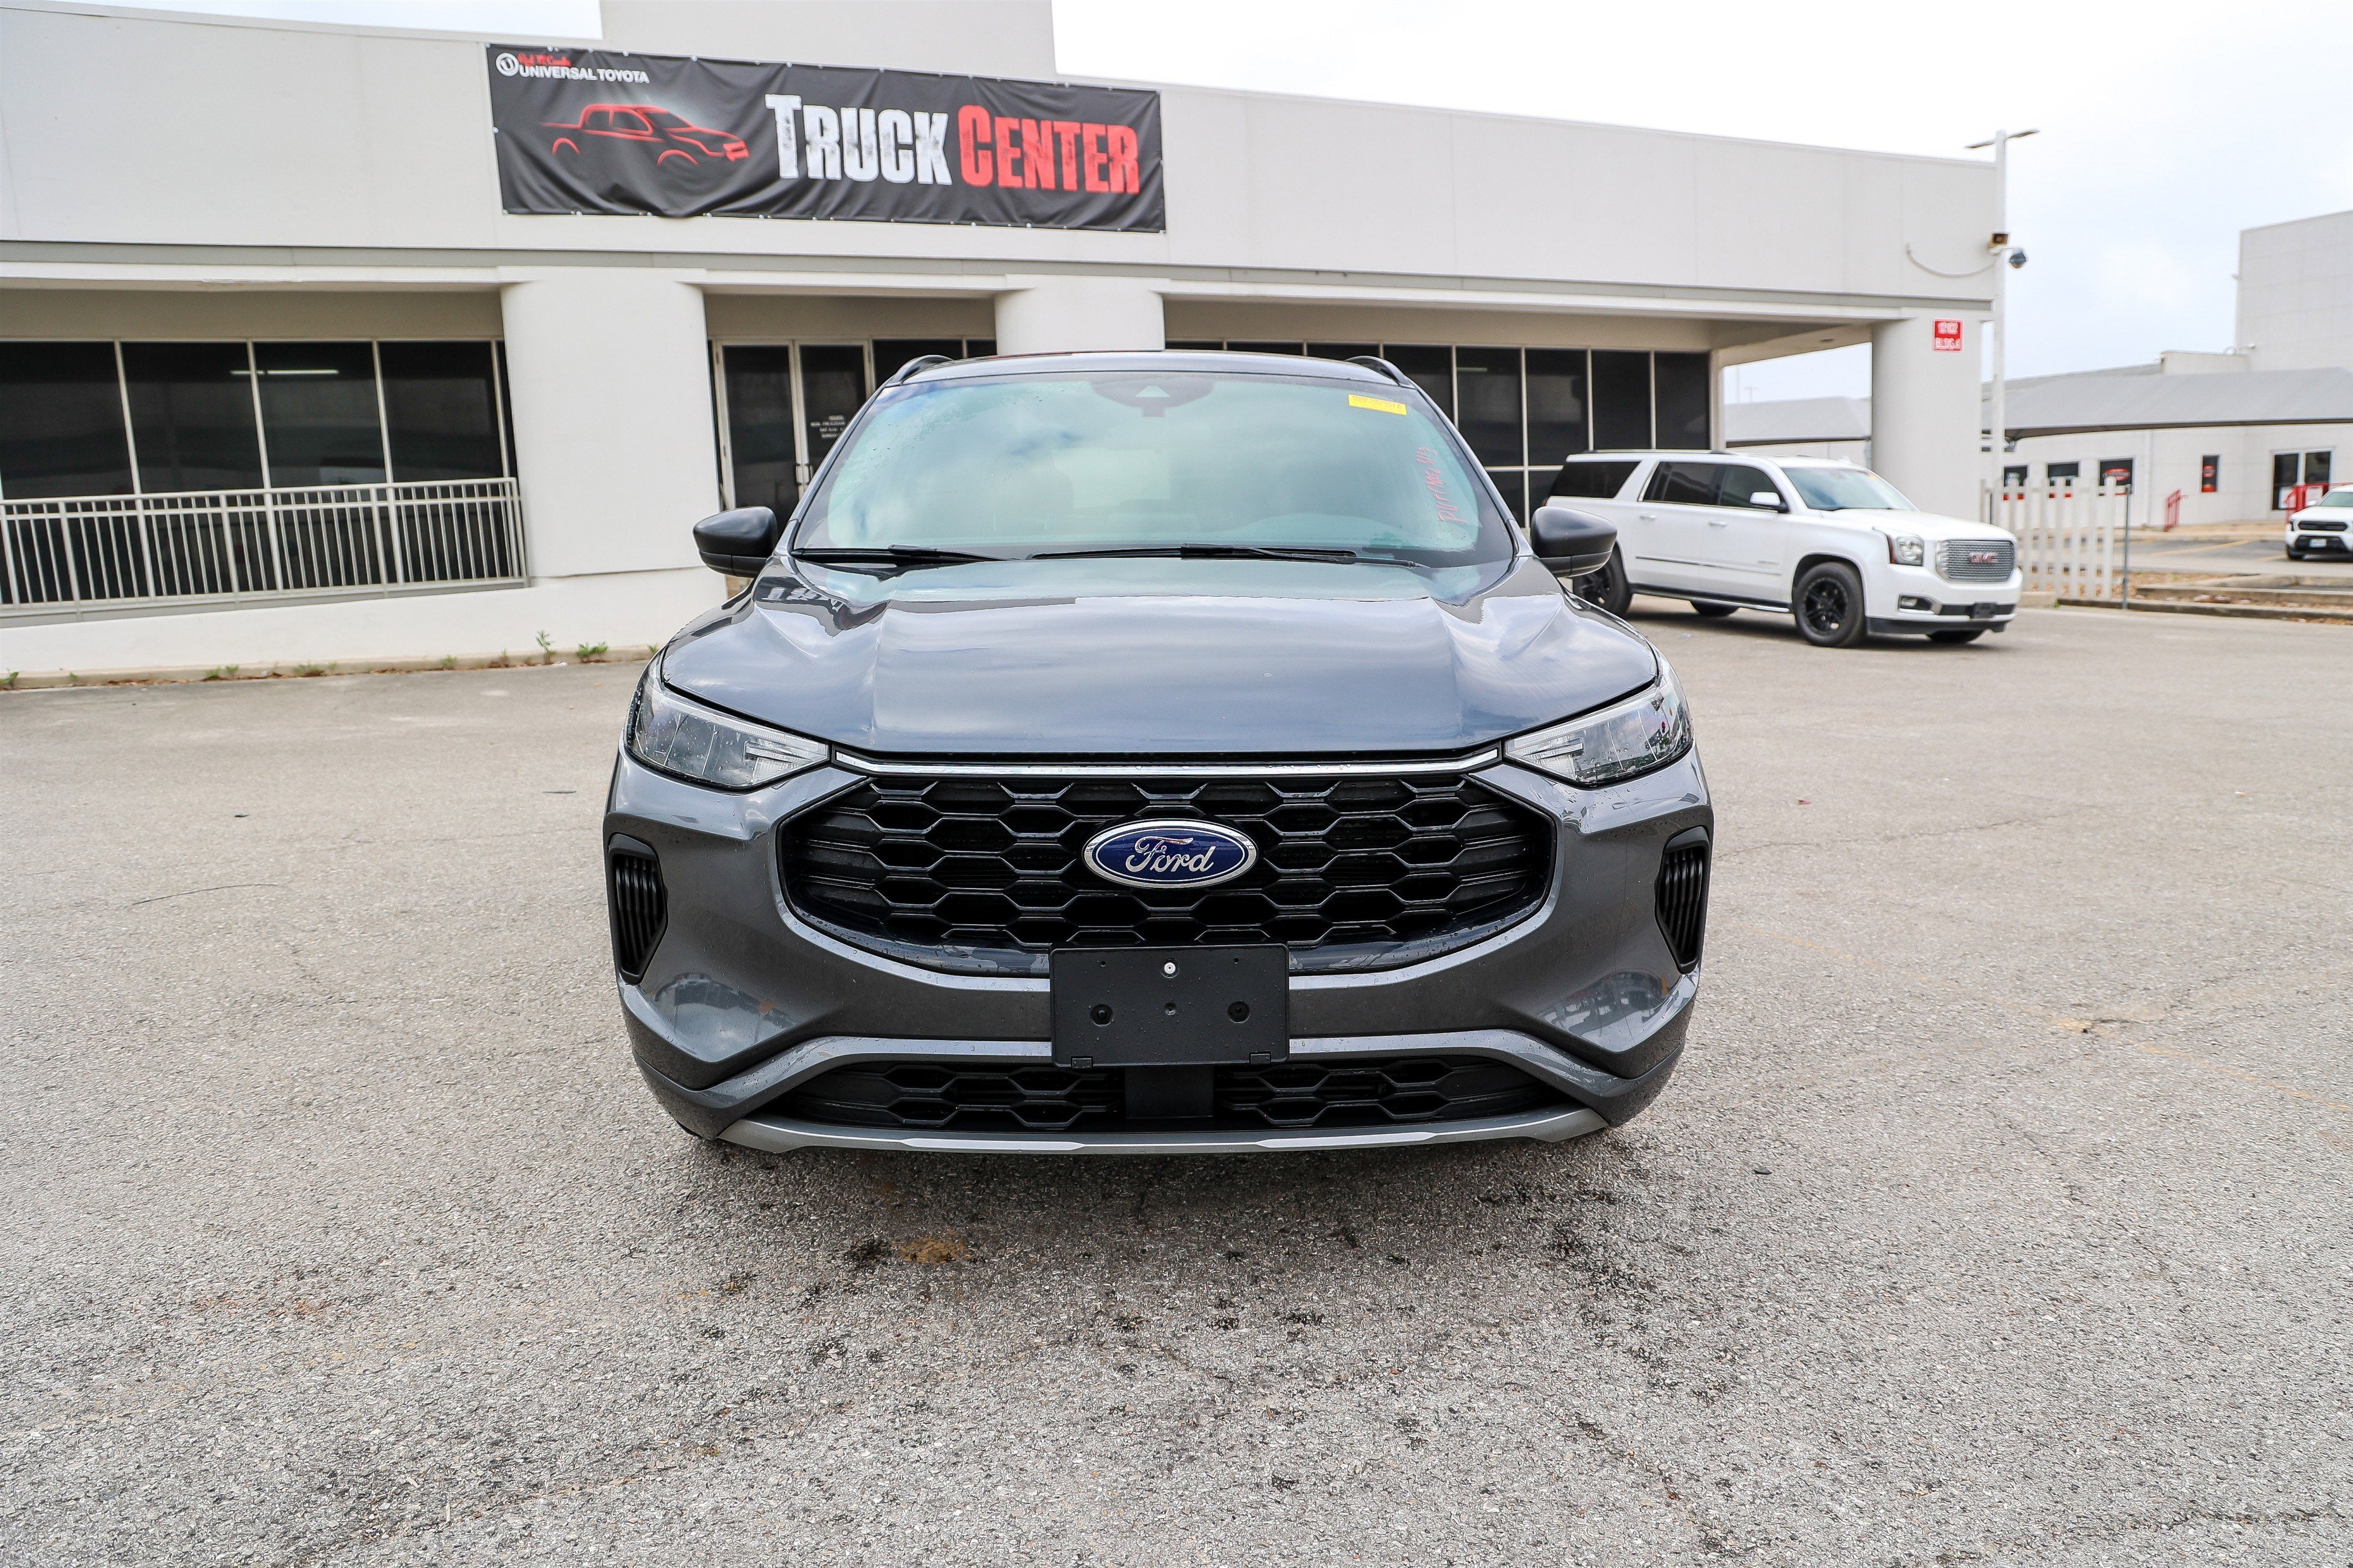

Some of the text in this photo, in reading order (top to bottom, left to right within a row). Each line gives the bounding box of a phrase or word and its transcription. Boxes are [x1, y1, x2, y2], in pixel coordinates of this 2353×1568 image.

[519, 64, 650, 84] UNIVERSAL TOYOTA
[765, 94, 1139, 194] TRUCK CENTER
[1969, 553, 1999, 563] GMC
[1126, 836, 1216, 872] Ford
